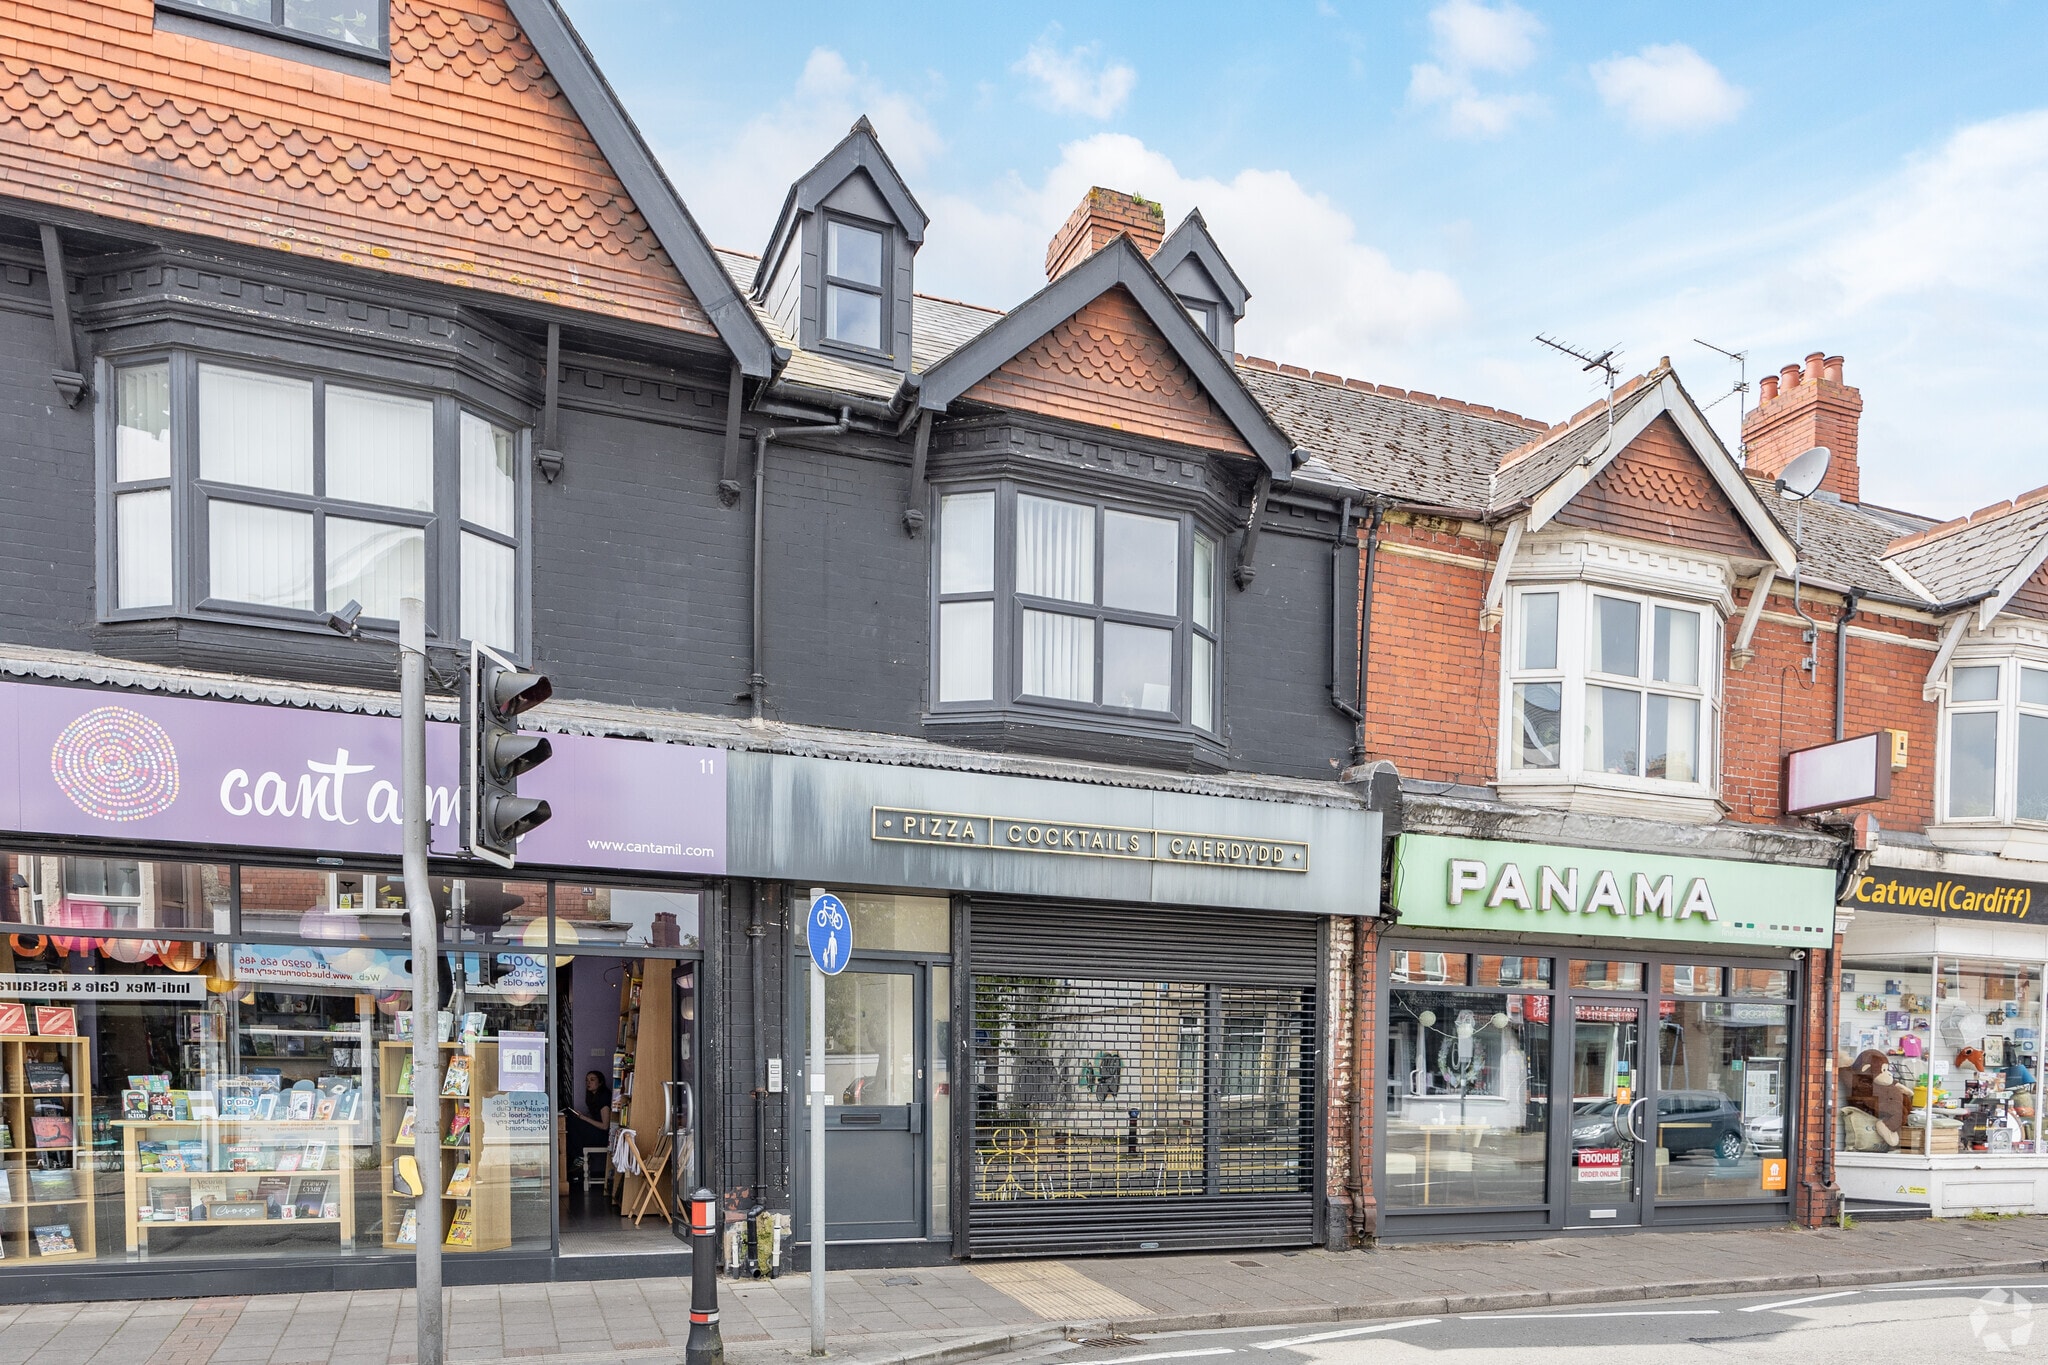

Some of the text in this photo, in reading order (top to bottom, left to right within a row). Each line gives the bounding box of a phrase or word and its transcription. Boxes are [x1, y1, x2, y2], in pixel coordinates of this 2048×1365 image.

[699, 758, 715, 775] 11
[903, 816, 976, 839] PIZZA
[1006, 825, 1141, 852] COCKTAILS
[587, 837, 715, 858] www.cantamil.com
[1169, 837, 1286, 864] CAERDYDD
[1448, 858, 1719, 922] PANAMA
[1855, 876, 2031, 918] Catwel(Cardiff)
[1580, 1152, 1620, 1163] FOODHUB
[457, 1208, 468, 1221] 10
